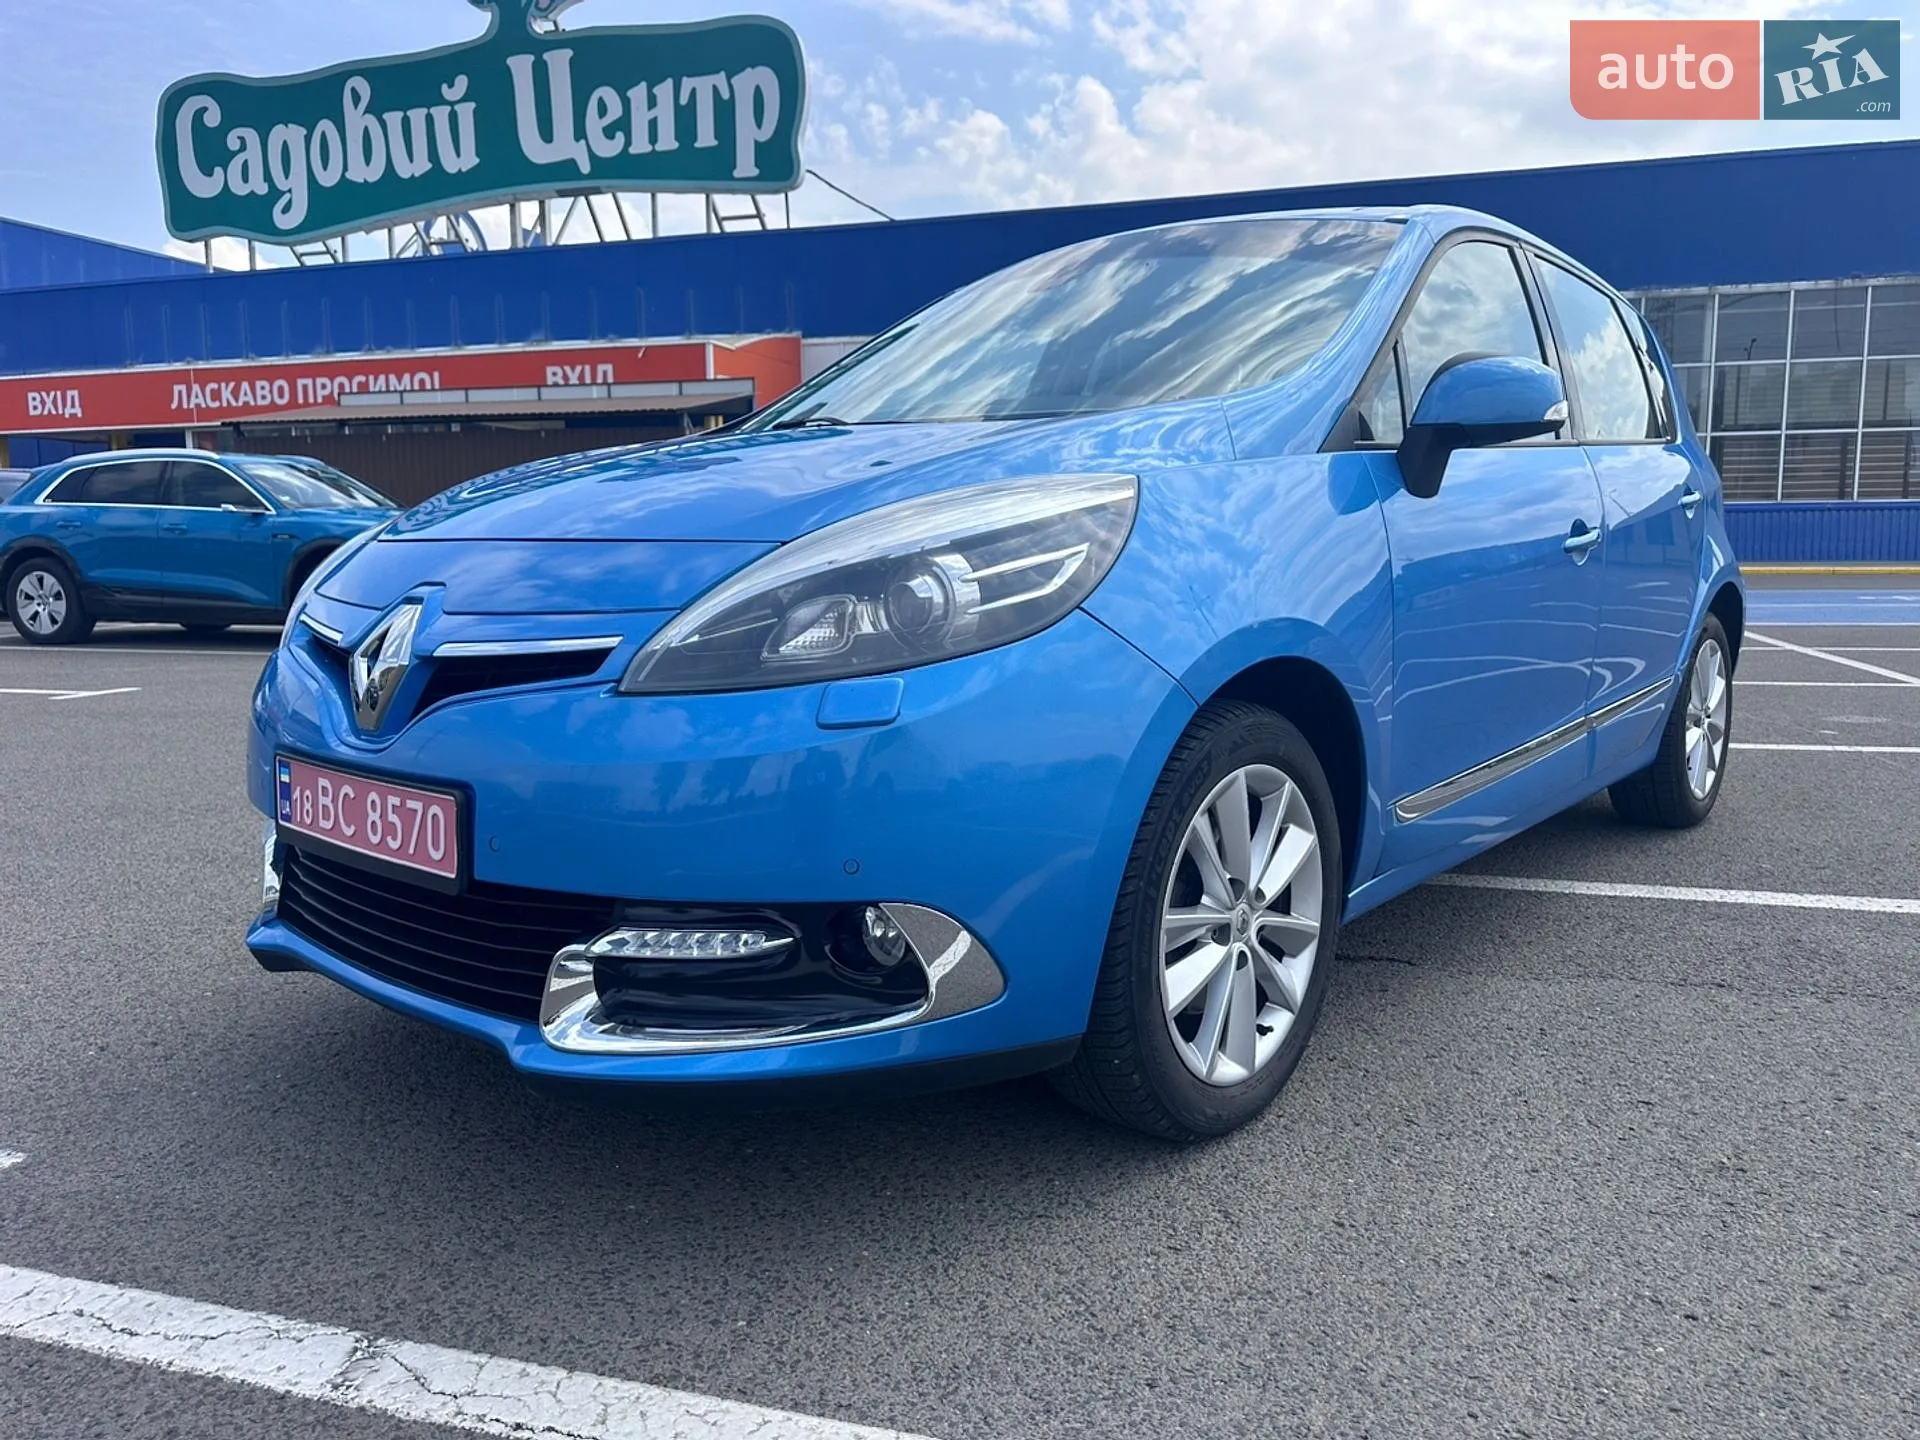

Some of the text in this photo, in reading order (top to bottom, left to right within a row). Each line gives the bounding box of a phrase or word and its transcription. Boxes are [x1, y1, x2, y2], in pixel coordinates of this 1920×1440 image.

[176, 48, 780, 230] Садовий Центр
[27, 389, 82, 418] ВХІД
[170, 378, 290, 409] ЛАСКАВО
[366, 791, 445, 861] 8570
